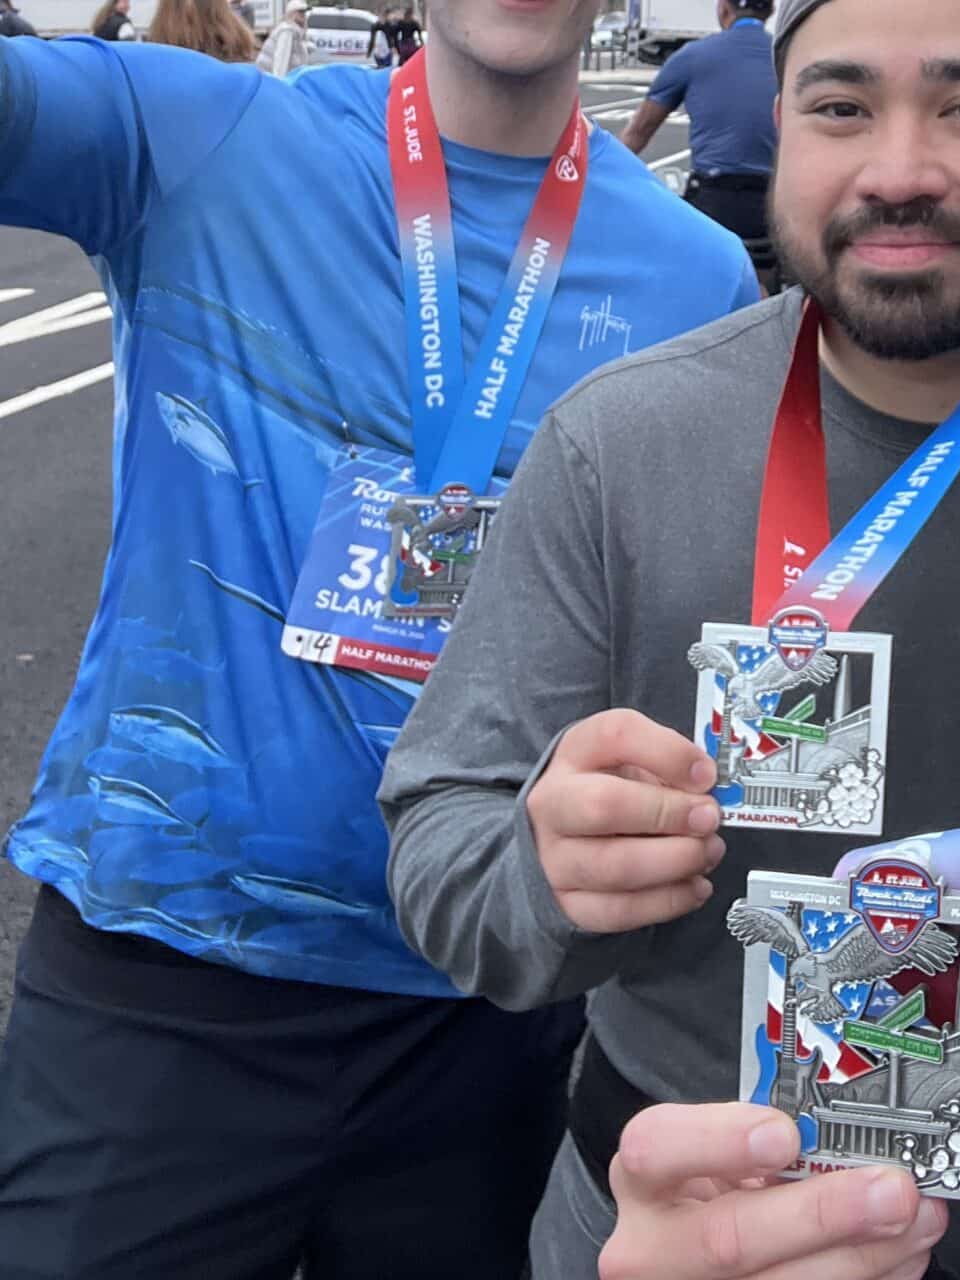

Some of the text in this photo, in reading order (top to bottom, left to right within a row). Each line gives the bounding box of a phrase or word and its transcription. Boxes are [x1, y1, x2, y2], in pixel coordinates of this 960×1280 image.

[315, 38, 364, 50] OLICE
[413, 213, 445, 409] WASHINGTON DC
[474, 237, 551, 419] HALF MARATHON
[810, 440, 955, 601] HALF MARATHON
[341, 646, 433, 670] HALF MARATHO
[737, 813, 798, 825] MARATHON
